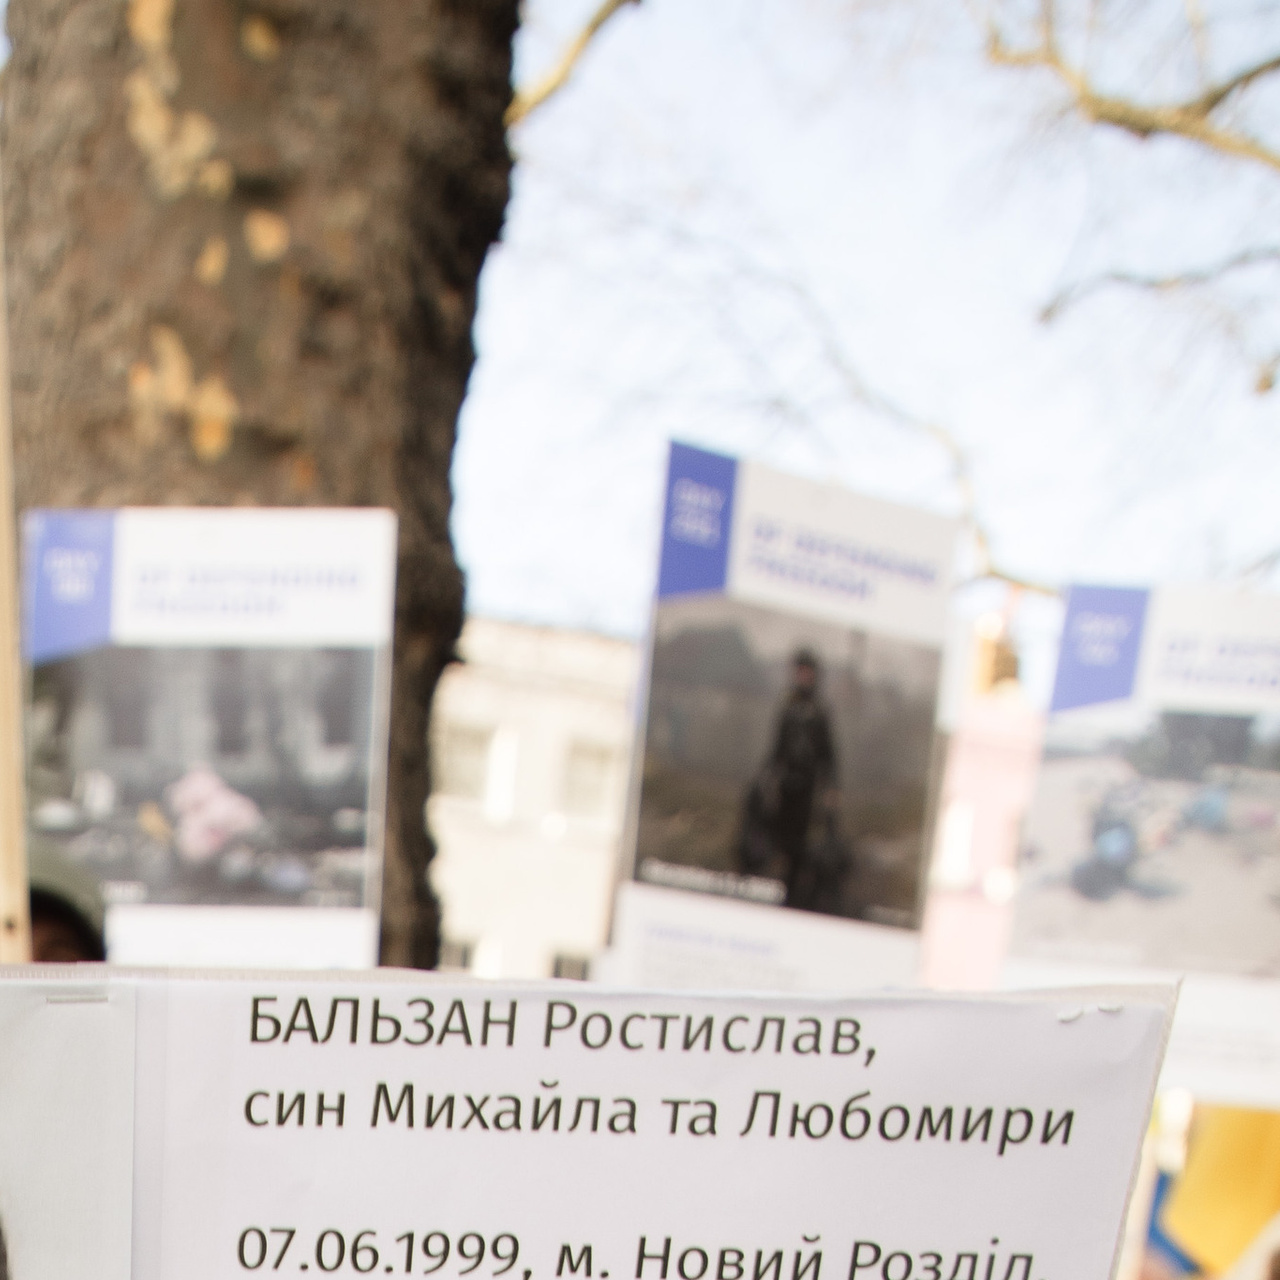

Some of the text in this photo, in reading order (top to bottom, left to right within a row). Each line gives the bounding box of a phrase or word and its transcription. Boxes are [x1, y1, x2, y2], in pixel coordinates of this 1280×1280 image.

[250, 996, 876, 1068] БАЛЬЗАН Ростислав,
[244, 1080, 1075, 1157] син Михайла та Любомири
[555, 1244, 609, 1279] м.
